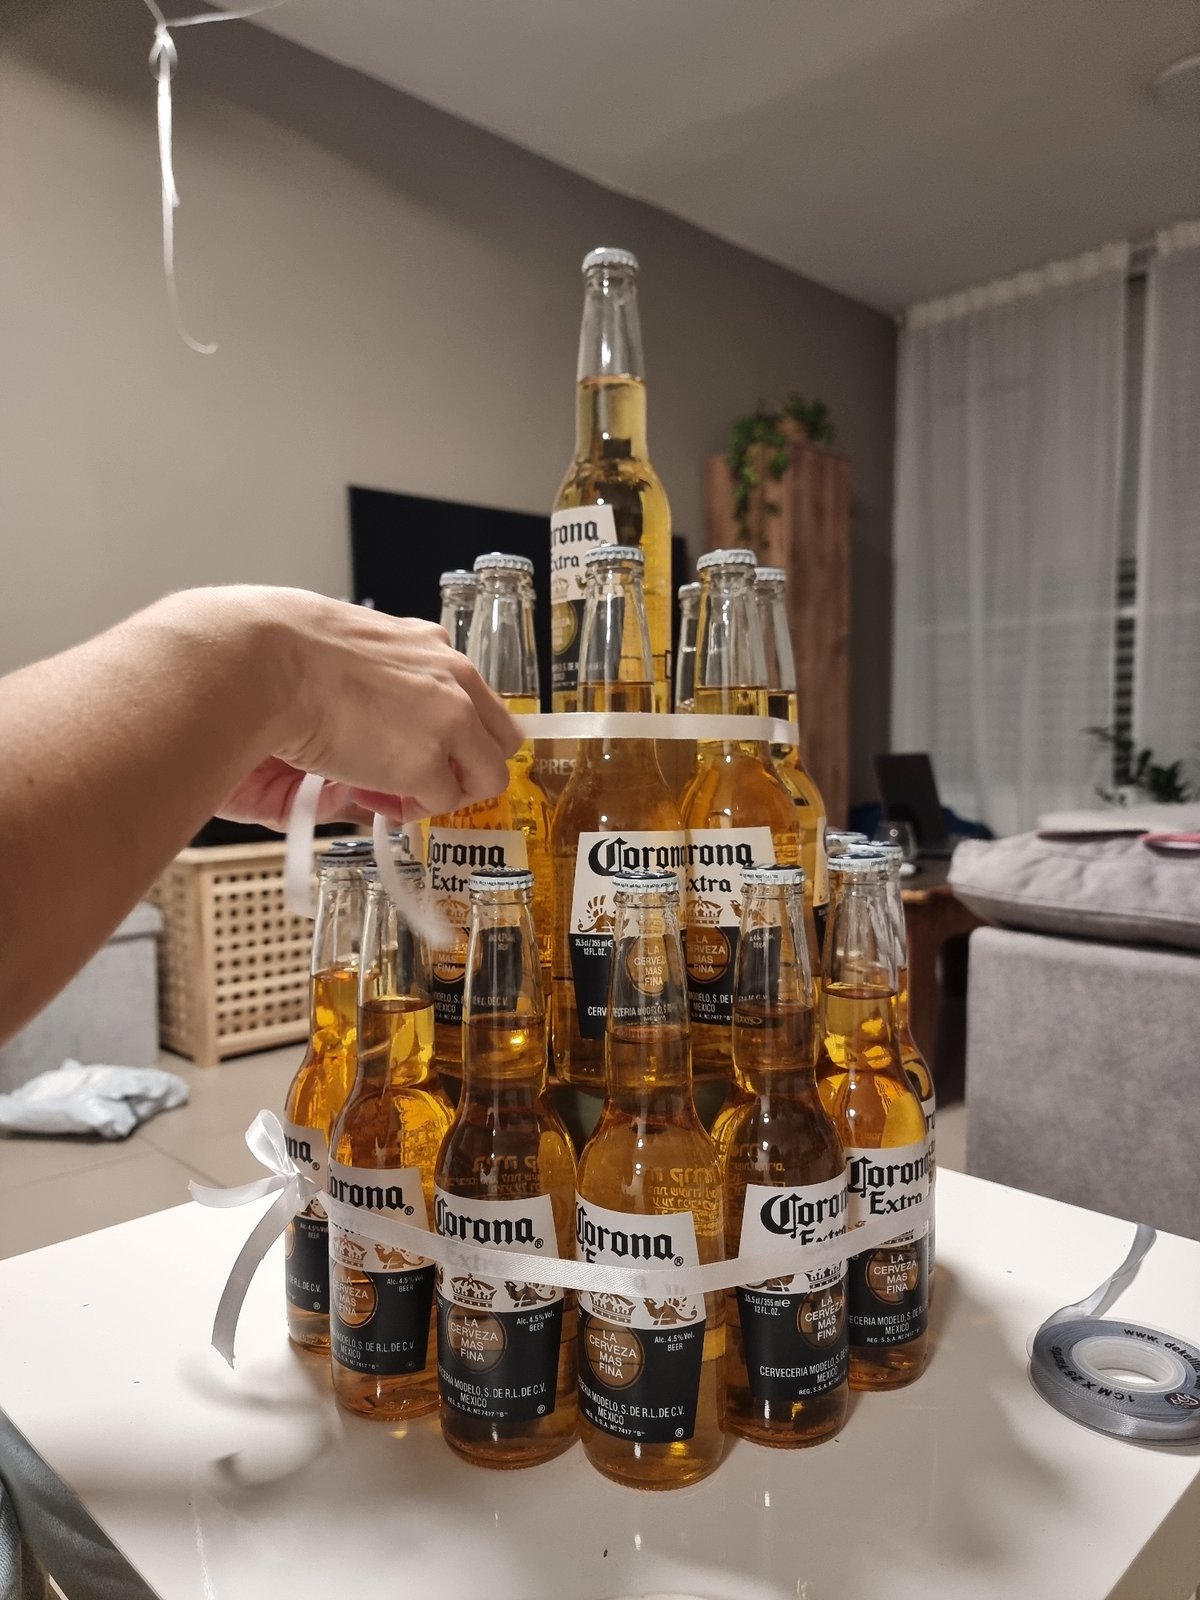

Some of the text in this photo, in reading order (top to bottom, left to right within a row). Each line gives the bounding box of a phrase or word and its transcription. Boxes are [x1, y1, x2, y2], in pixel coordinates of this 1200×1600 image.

[552, 521, 600, 547] rona
[552, 555, 580, 571] xtra
[687, 842, 755, 867] rona
[430, 866, 470, 892] Extr
[687, 875, 732, 893] xtra
[696, 935, 708, 944] LA
[634, 956, 667, 967] CERVE
[693, 963, 714, 974] FINA
[644, 977, 664, 986] FINA
[330, 1176, 406, 1210] orona
[890, 1254, 904, 1264] LA
[873, 1259, 918, 1275] CERVEZA
[886, 1272, 908, 1284] MAS
[335, 1281, 369, 1299] ERVEZA
[886, 1283, 909, 1294] FINA
[821, 1296, 834, 1307] LA
[516, 1310, 555, 1326] Alc. 4.5% Vol.
[804, 1301, 844, 1322] CERVEZA
[849, 1315, 877, 1326] ECERIA
[877, 1312, 907, 1325] MODELO,
[464, 1316, 479, 1328] LA
[529, 1322, 544, 1332] BEER
[817, 1315, 836, 1330] MAS
[885, 1322, 910, 1335] MEXICO
[450, 1323, 498, 1341] CERVEZA
[602, 1329, 617, 1343] LA
[654, 1331, 695, 1344] Alc. 4.5% Vol.
[817, 1326, 837, 1341] FINA
[340, 1343, 361, 1360] MEXICO
[366, 1342, 375, 1352] DE
[391, 1342, 400, 1352] DE
[460, 1337, 484, 1351] MAS
[589, 1334, 637, 1358] CERVEZA
[667, 1343, 683, 1352] BEER
[460, 1348, 485, 1362] FINA
[600, 1351, 623, 1367] MAS
[599, 1362, 623, 1379] FINA
[760, 1365, 809, 1378] CERVECERIA
[817, 1365, 839, 1384] MEXICO
[1064, 1370, 1085, 1381] 25
[454, 1378, 484, 1398] MODELO,
[484, 1387, 492, 1398] S.
[493, 1388, 503, 1398] DE
[505, 1388, 521, 1399] R.L.
[521, 1386, 532, 1397] DE
[532, 1383, 547, 1395] C.V.
[460, 1392, 487, 1408] MEXICO
[592, 1391, 684, 1418] MODELO, S. DE R.L. DE C.V.
[597, 1406, 624, 1426] MEXICO
[618, 1426, 632, 1435] 7417
